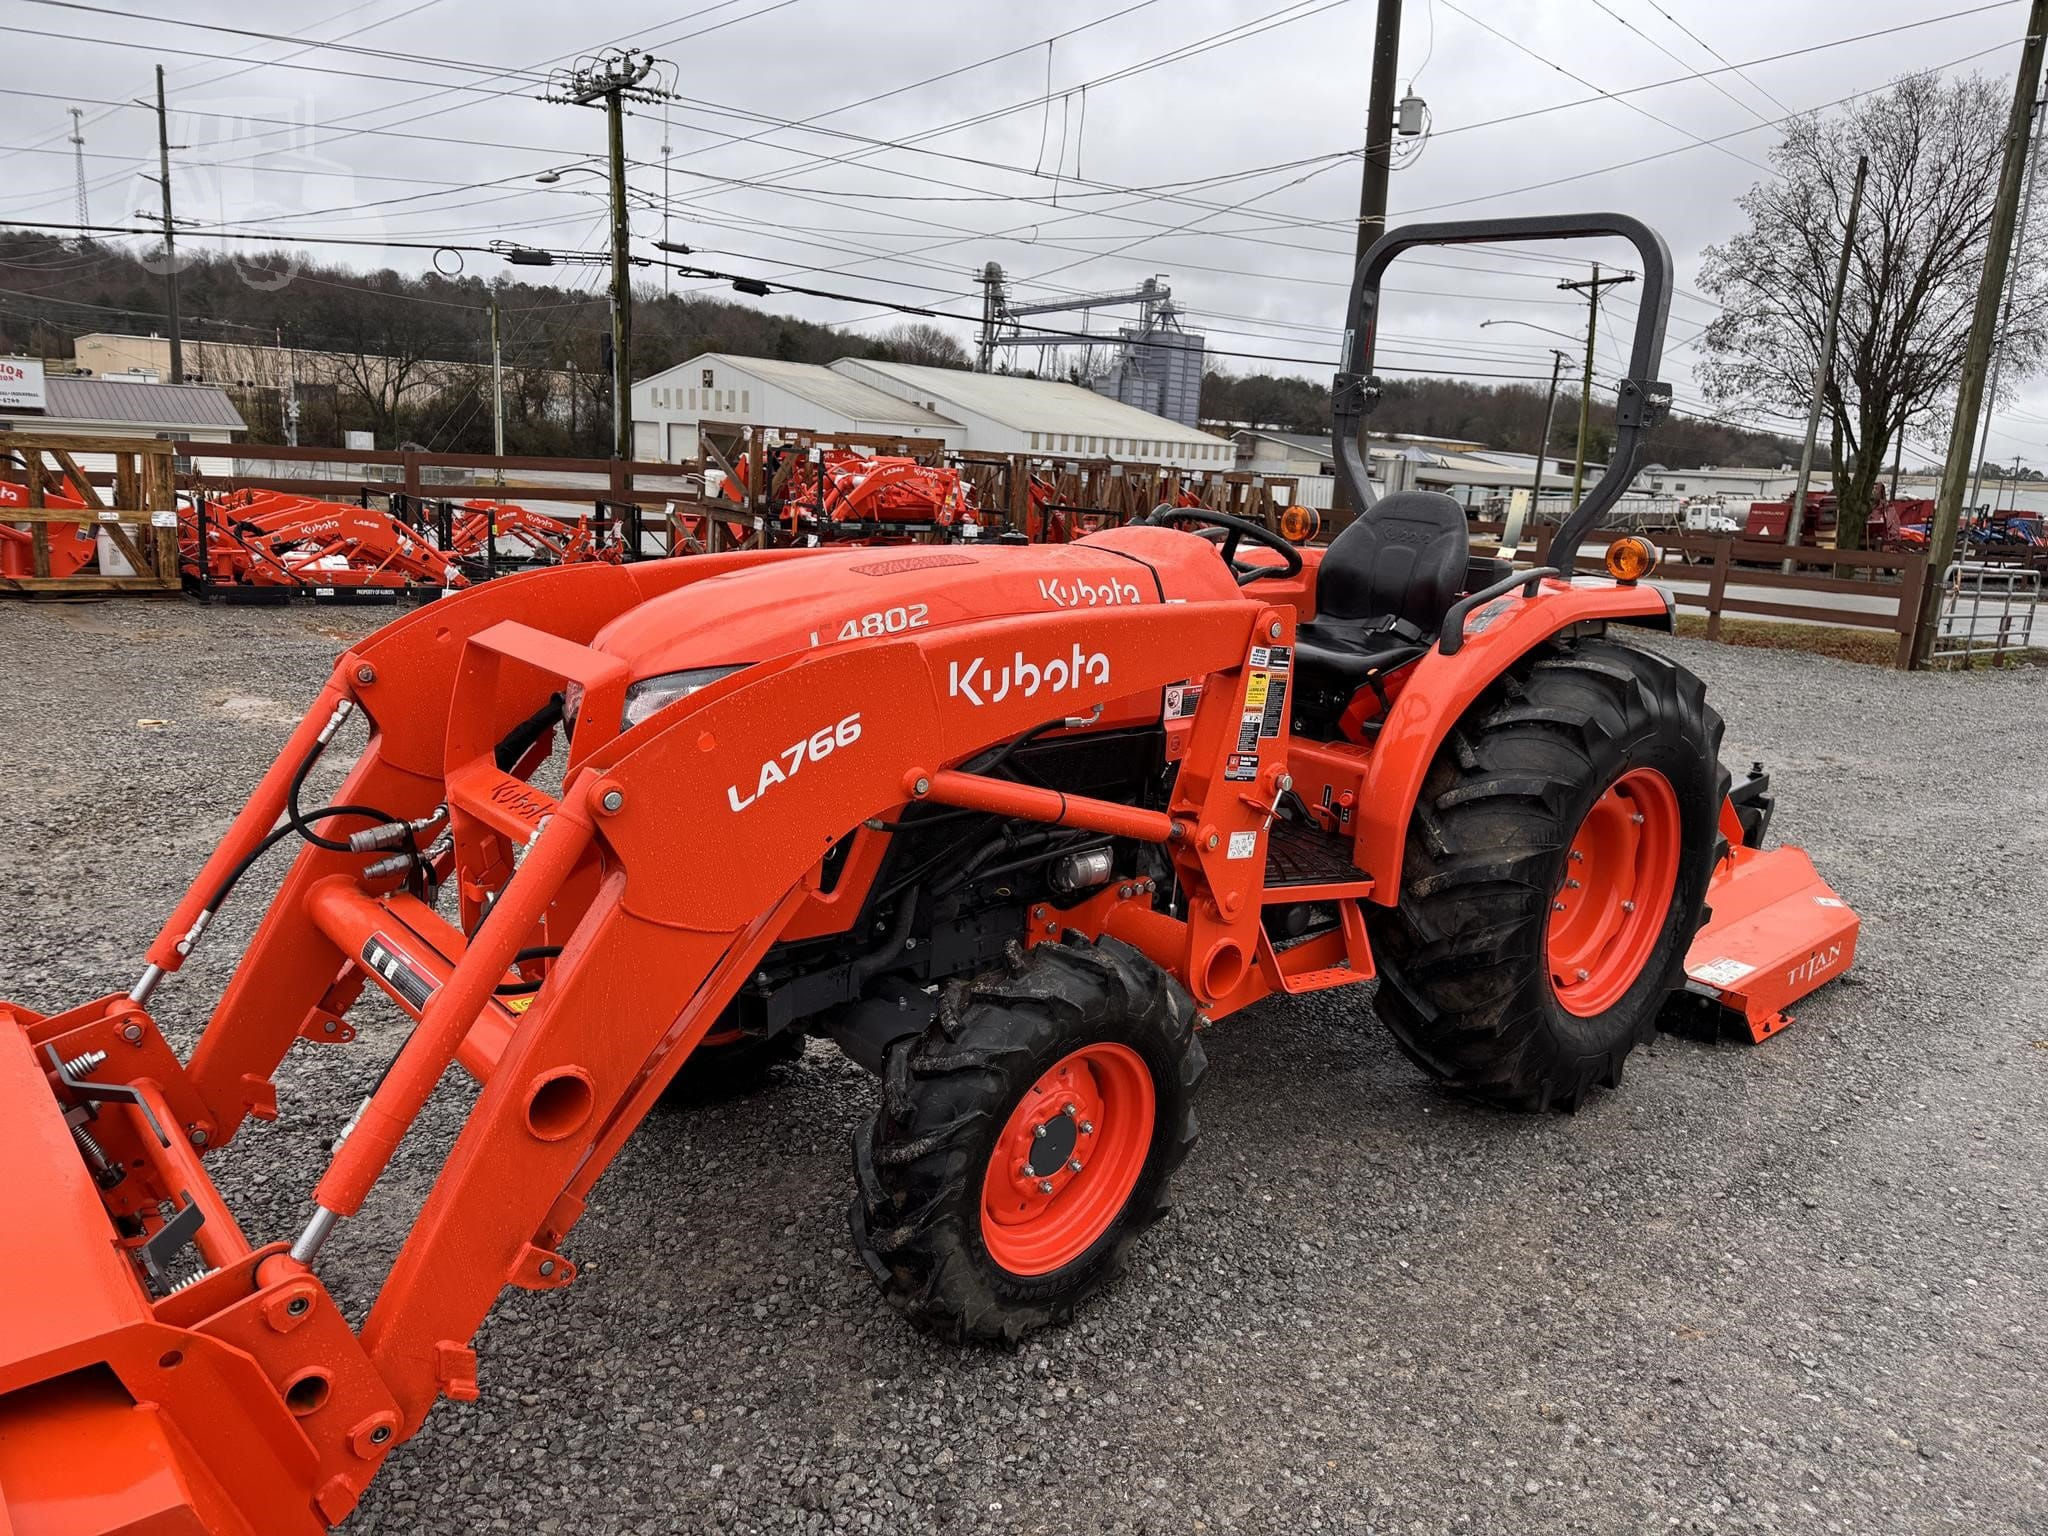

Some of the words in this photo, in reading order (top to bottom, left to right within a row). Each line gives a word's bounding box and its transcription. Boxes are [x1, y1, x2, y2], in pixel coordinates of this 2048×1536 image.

[300, 519, 340, 535] Kubota
[1037, 576, 1141, 607] Kubota
[949, 642, 1111, 707] Kubota
[727, 712, 862, 813] LA766
[1786, 940, 1842, 986] TITAN
